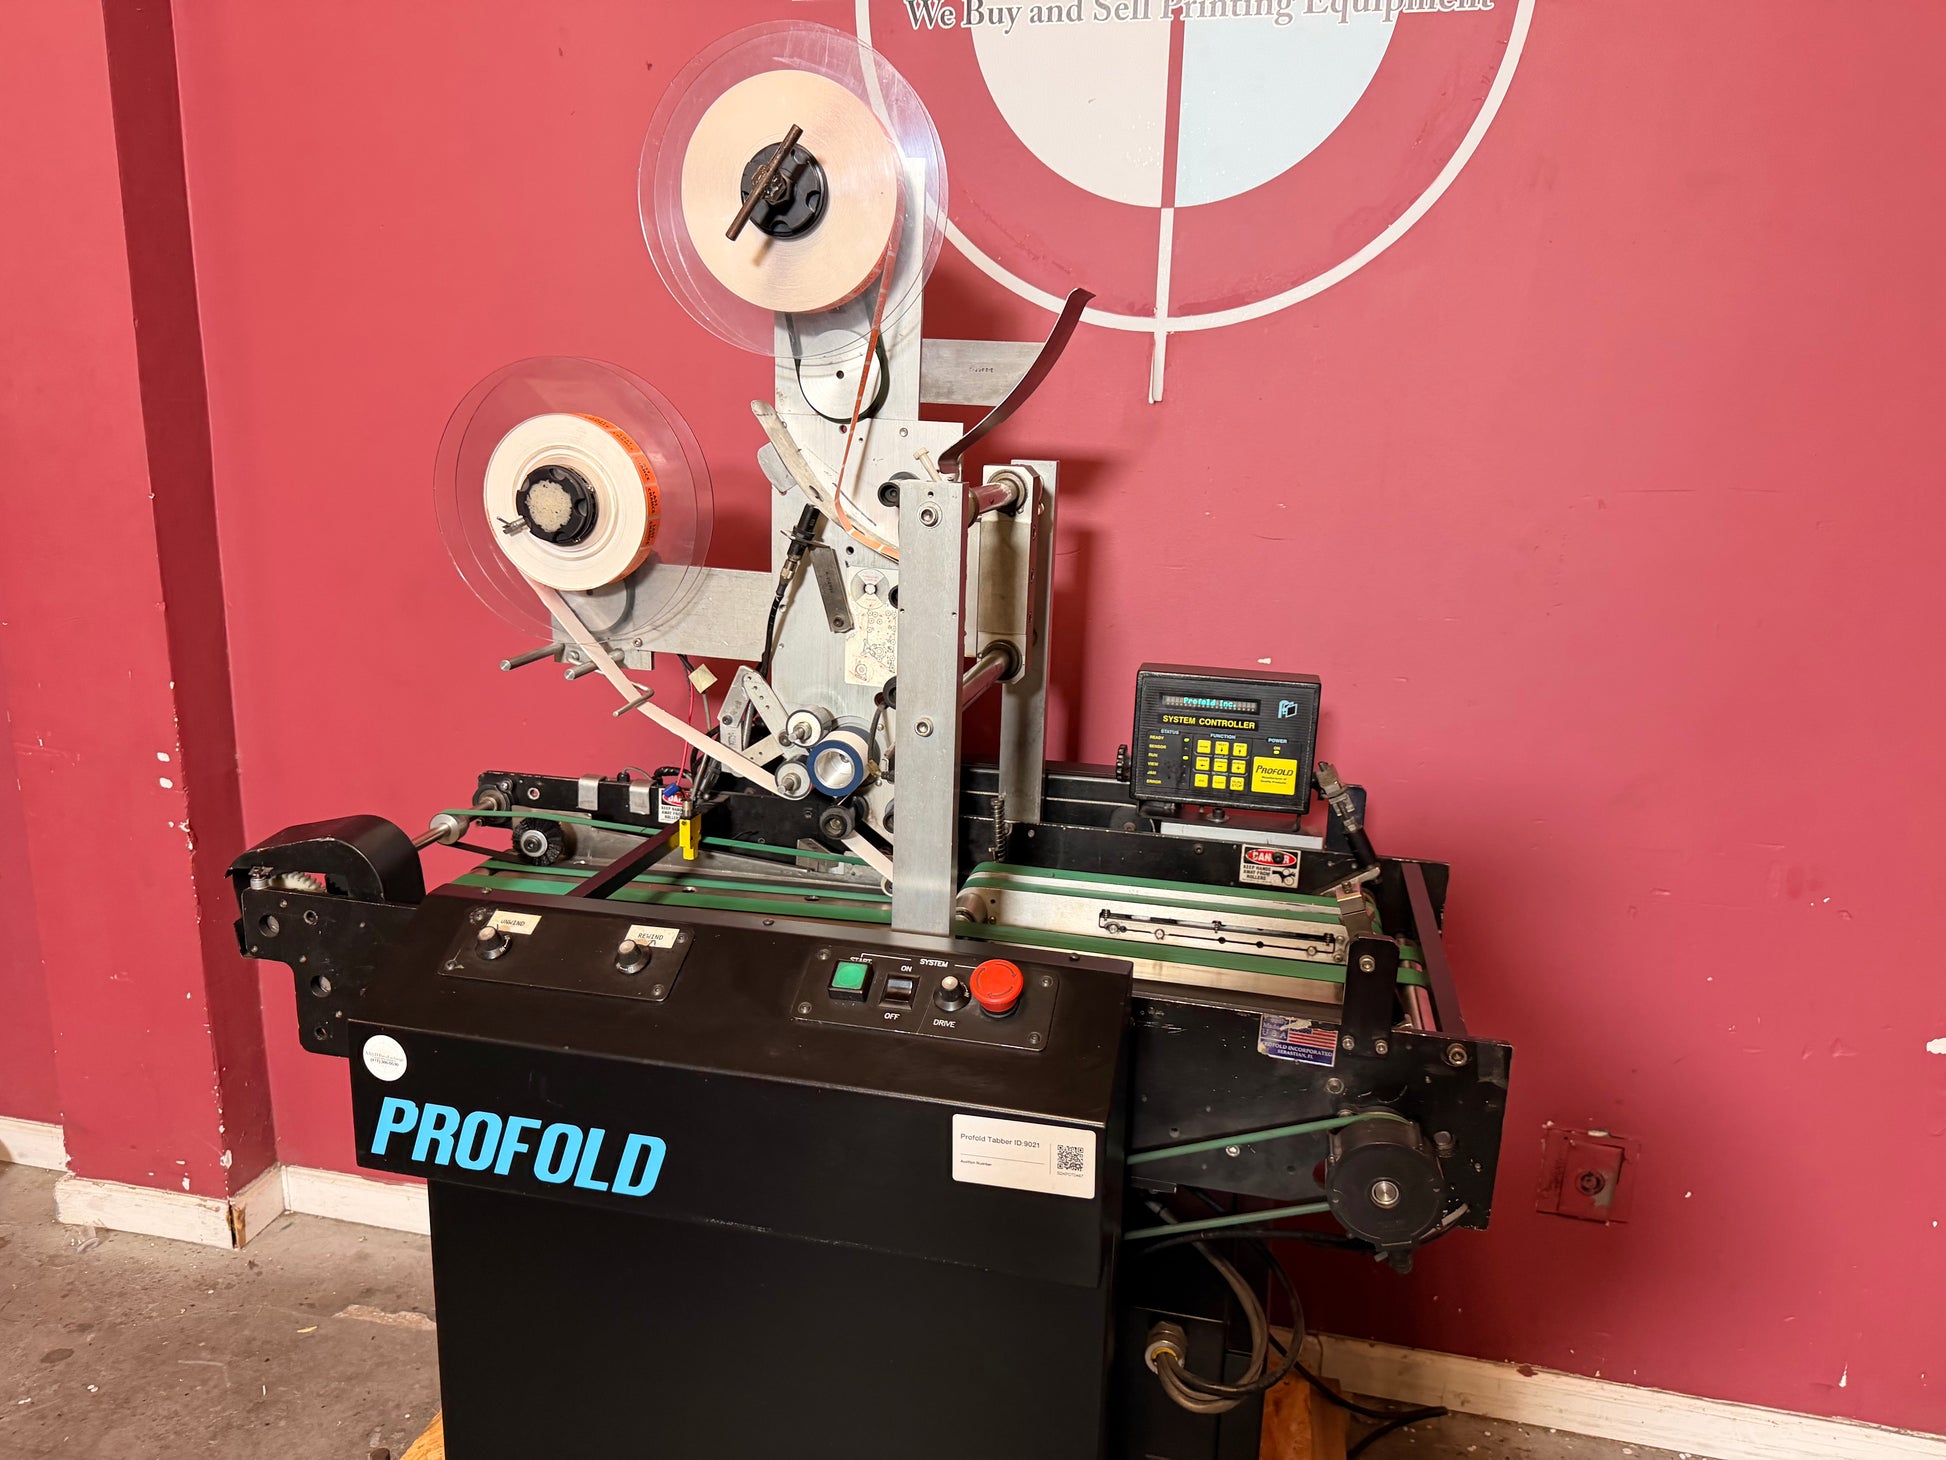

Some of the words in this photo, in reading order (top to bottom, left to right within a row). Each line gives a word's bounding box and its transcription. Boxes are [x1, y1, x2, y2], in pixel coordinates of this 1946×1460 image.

[906, 0, 954, 28] We
[962, 0, 1022, 34] Buy
[1029, 0, 1084, 24] and
[1093, 0, 1151, 21] Sell
[1160, 0, 1294, 25] Printing
[1183, 697, 1216, 707] Profold
[1219, 700, 1237, 708] Inc.
[1162, 714, 1196, 725] SYSTEM
[1199, 717, 1256, 730] CONTROLLER
[1255, 765, 1294, 776] PROFOLD
[920, 958, 948, 968] SYSTEM
[884, 1012, 900, 1020] OFF
[933, 1019, 956, 1028] DRIVE
[1288, 1045, 1333, 1057] INCORPORATED
[960, 1133, 986, 1142] Profold
[988, 1136, 1013, 1145] Tabber
[371, 1096, 667, 1197] PROFOLD
